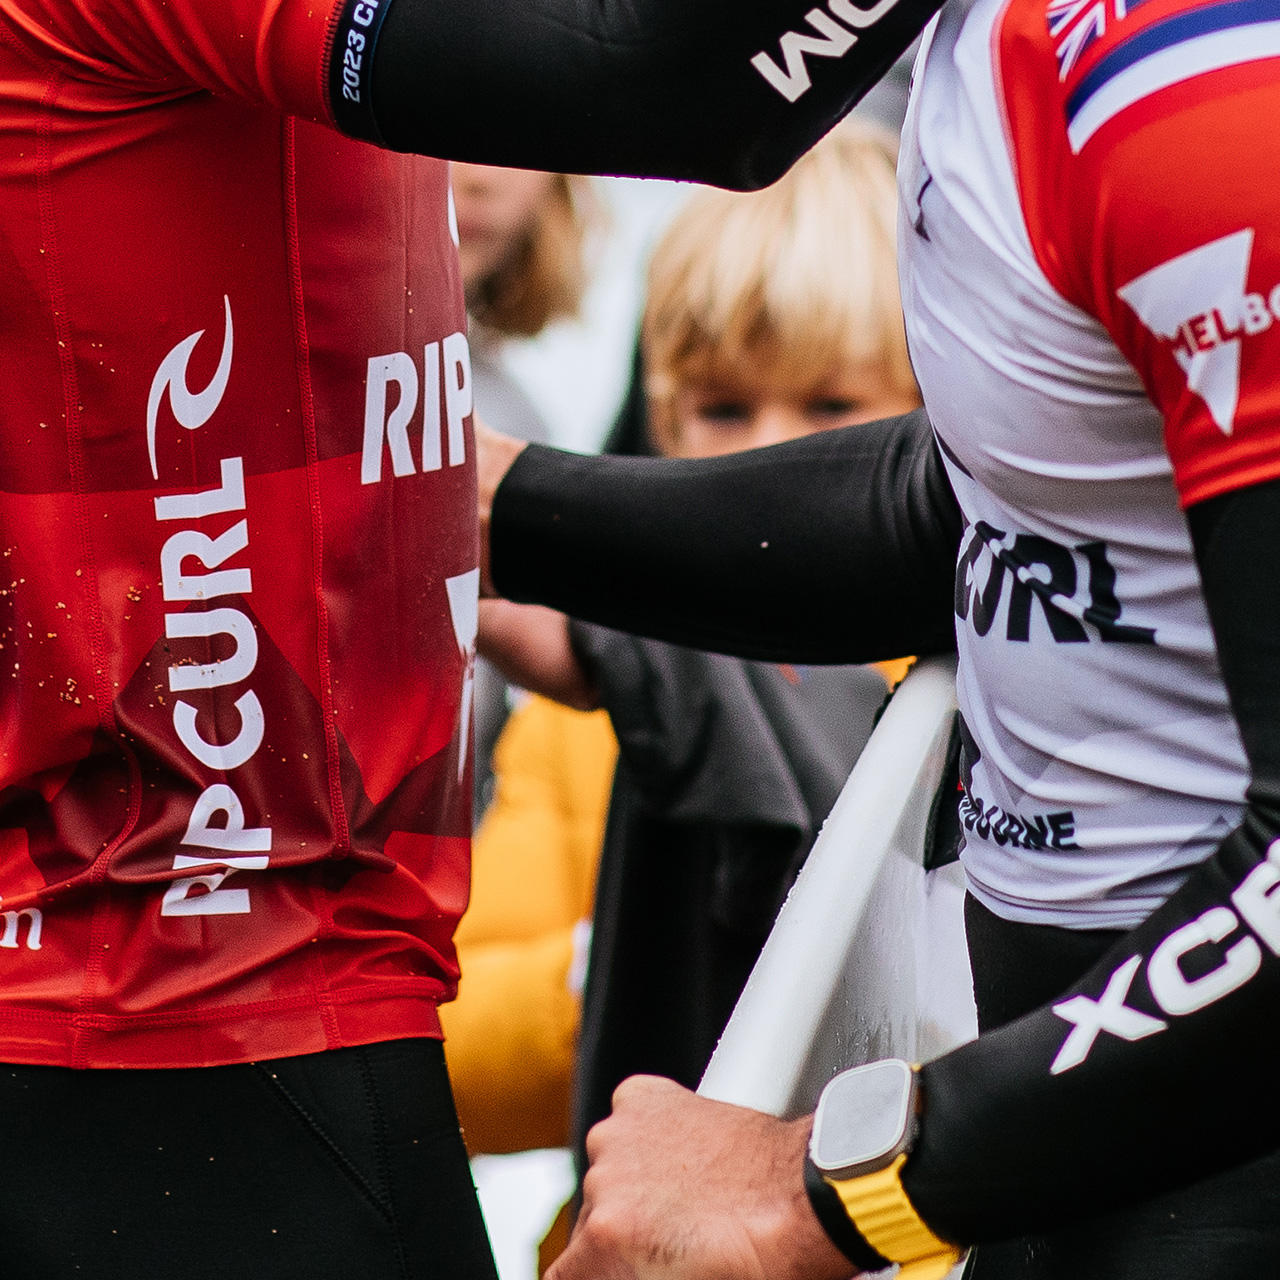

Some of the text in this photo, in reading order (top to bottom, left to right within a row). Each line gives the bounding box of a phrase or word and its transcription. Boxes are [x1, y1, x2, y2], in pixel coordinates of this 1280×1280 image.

[342, 29, 366, 104] 2023
[360, 332, 474, 485] RIP
[153, 456, 273, 917] RIP CURL
